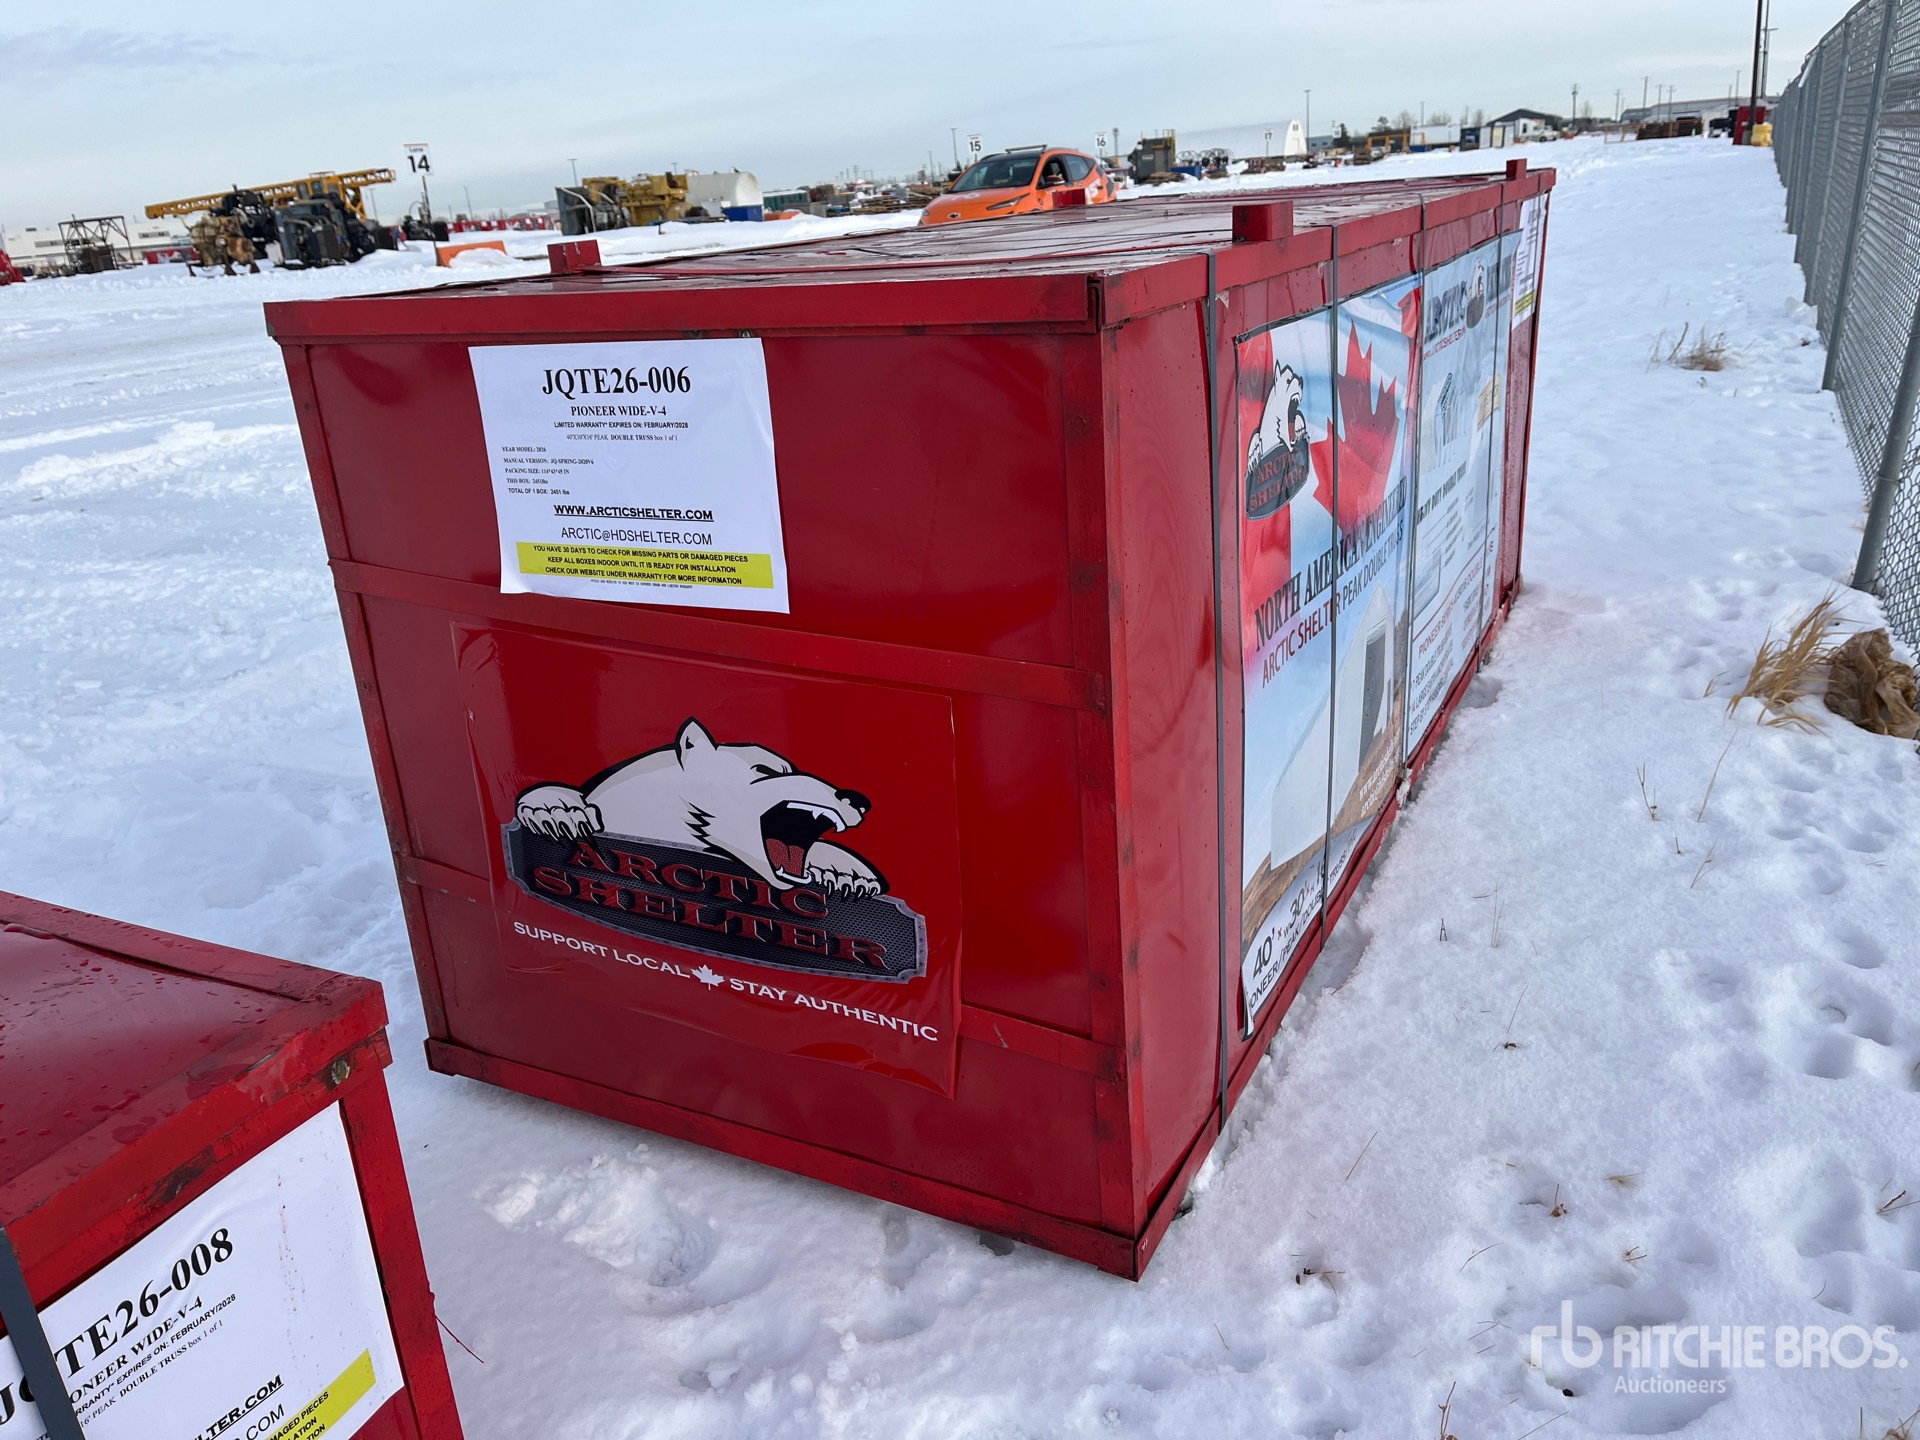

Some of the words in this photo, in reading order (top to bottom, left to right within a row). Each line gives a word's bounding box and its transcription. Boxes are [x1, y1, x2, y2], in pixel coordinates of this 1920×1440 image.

[969, 140, 982, 152] 15
[1096, 137, 1106, 147] 16
[407, 154, 430, 173] 14
[542, 366, 691, 400] JQTE26-006
[570, 405, 616, 417] PIONEER
[618, 405, 667, 416] WIDE-V-4
[554, 421, 575, 429] LIMITED
[608, 421, 632, 429] EXPIRES
[632, 421, 642, 429] ON:
[644, 421, 688, 429] FEBRUARY/2028
[654, 434, 663, 442] box
[668, 434, 675, 442] of
[554, 504, 714, 521] WWW.ARCTICSHELTER.COM
[561, 527, 712, 545] ARCTIC@HDSHELTER.COM
[576, 557, 596, 565] BOXES
[653, 562, 674, 570] READY
[675, 563, 689, 571] FOR
[690, 565, 736, 573] INSTALLATION
[631, 550, 656, 558] MISSING
[658, 551, 679, 559] PARTS
[690, 553, 723, 561] DAMAGED
[545, 566, 565, 574] CHECK
[566, 567, 579, 575] OUR
[580, 568, 605, 576] WEBSITE
[606, 570, 626, 578] UNDER
[627, 571, 662, 579] WARRANTY
[697, 576, 742, 585] INFORMATION
[1254, 571, 1302, 653] NORTH
[1262, 636, 1296, 689] ARCTIC
[1342, 570, 1364, 611] PEAK
[568, 842, 829, 919] ARCTIC
[534, 866, 891, 971] SHELTER
[513, 921, 609, 957] SUPPORT
[612, 948, 691, 979] LOCAL
[729, 978, 788, 1002] STAY
[793, 994, 939, 1041] AUTHENTIC
[116, 1353, 153, 1386] EXPIRES
[153, 1341, 170, 1356] ON:
[170, 1293, 237, 1344] FEBRUARY/2028
[69, 1354, 128, 1404] ONEER
[130, 1295, 203, 1356] WIDE-V-4
[92, 1396, 117, 1420] PEAK
[119, 1366, 158, 1399] DOUBLE
[158, 1345, 188, 1369] TRUSS
[187, 1335, 203, 1348] box
[209, 1321, 219, 1334] of
[300, 1391, 330, 1420] PIECES
